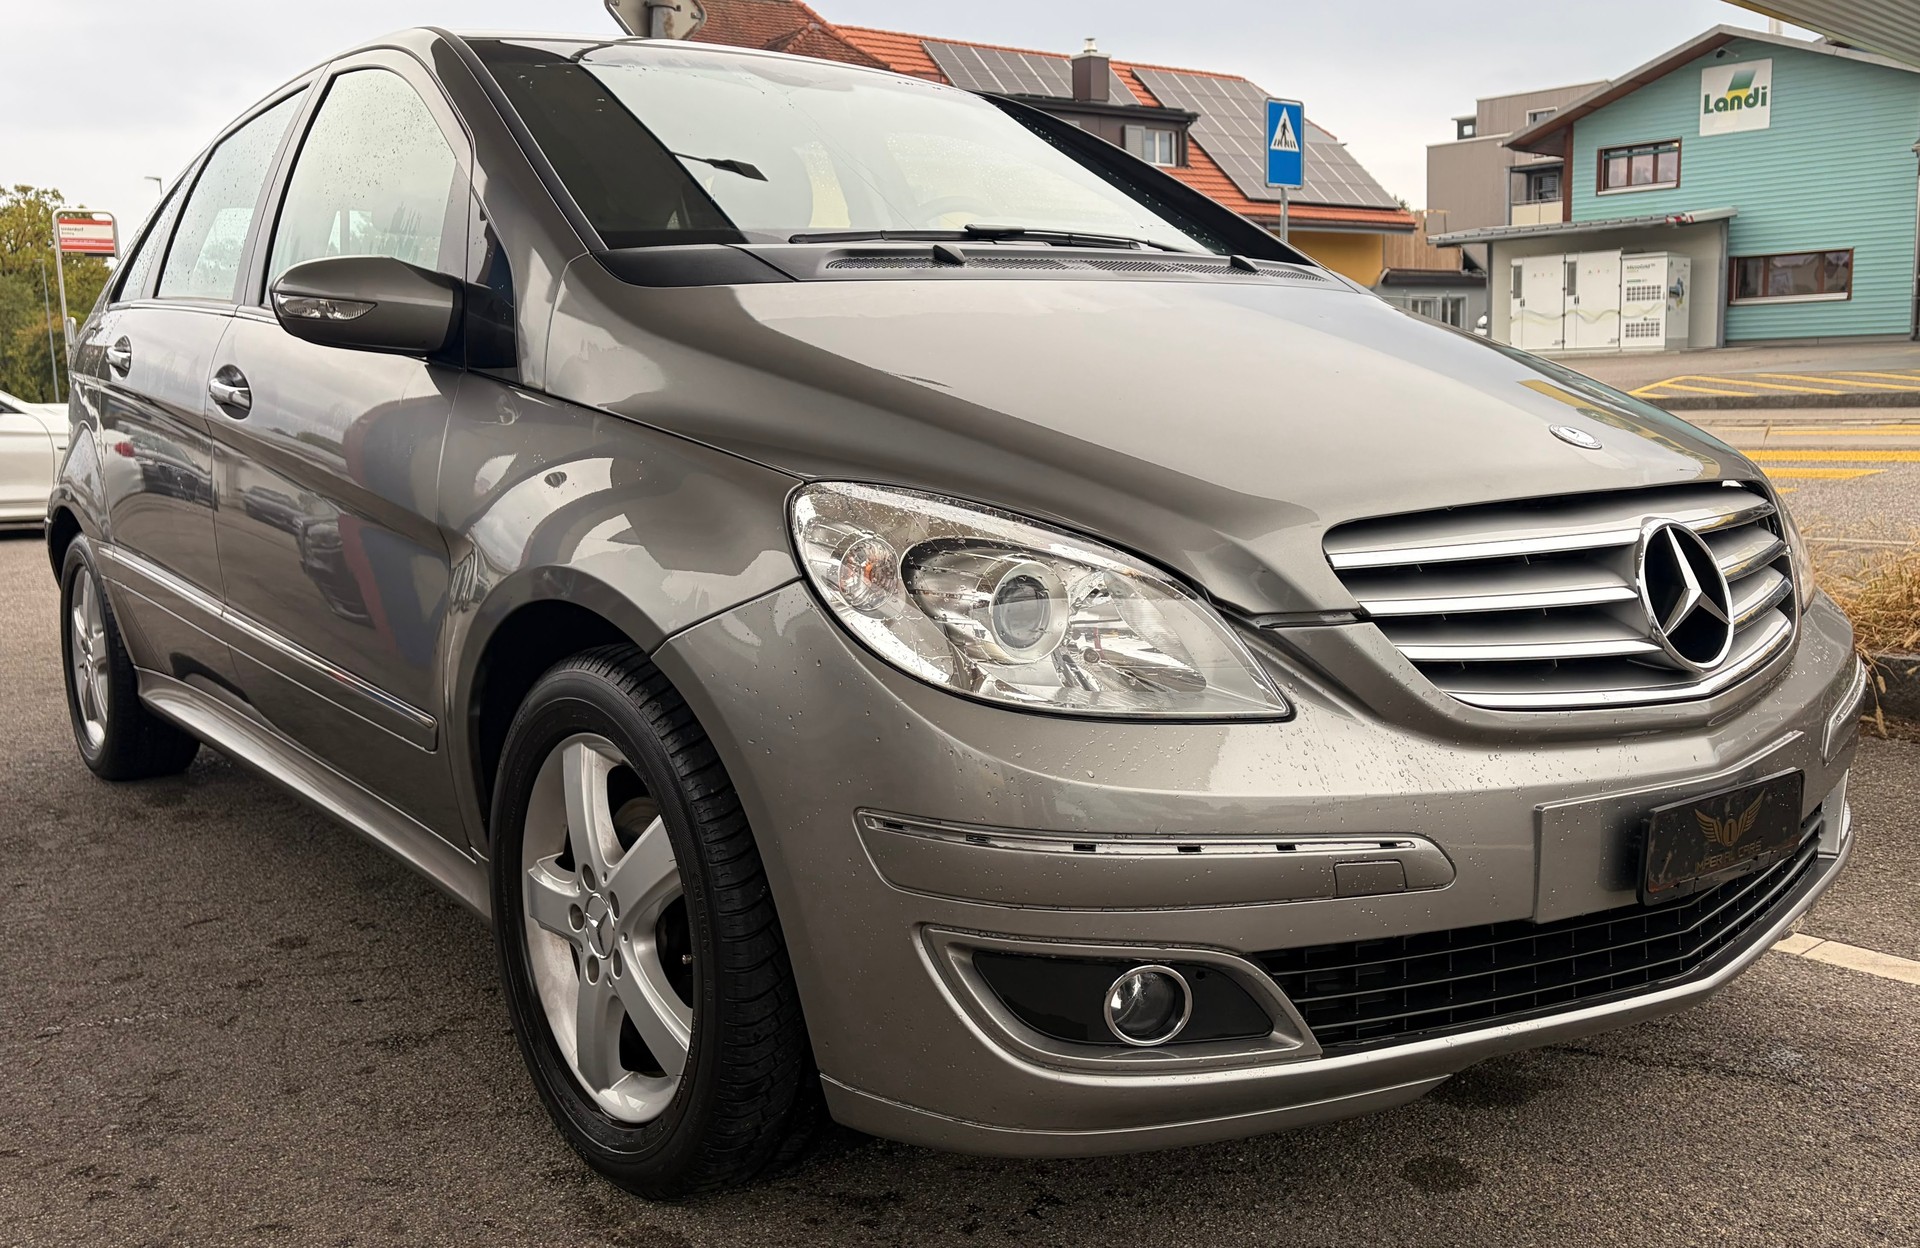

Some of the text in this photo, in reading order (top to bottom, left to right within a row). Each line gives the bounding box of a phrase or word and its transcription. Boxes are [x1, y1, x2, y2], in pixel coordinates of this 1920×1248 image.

[1703, 85, 1768, 115] Landi
[1694, 840, 1762, 873] IMPERIAL CARS
